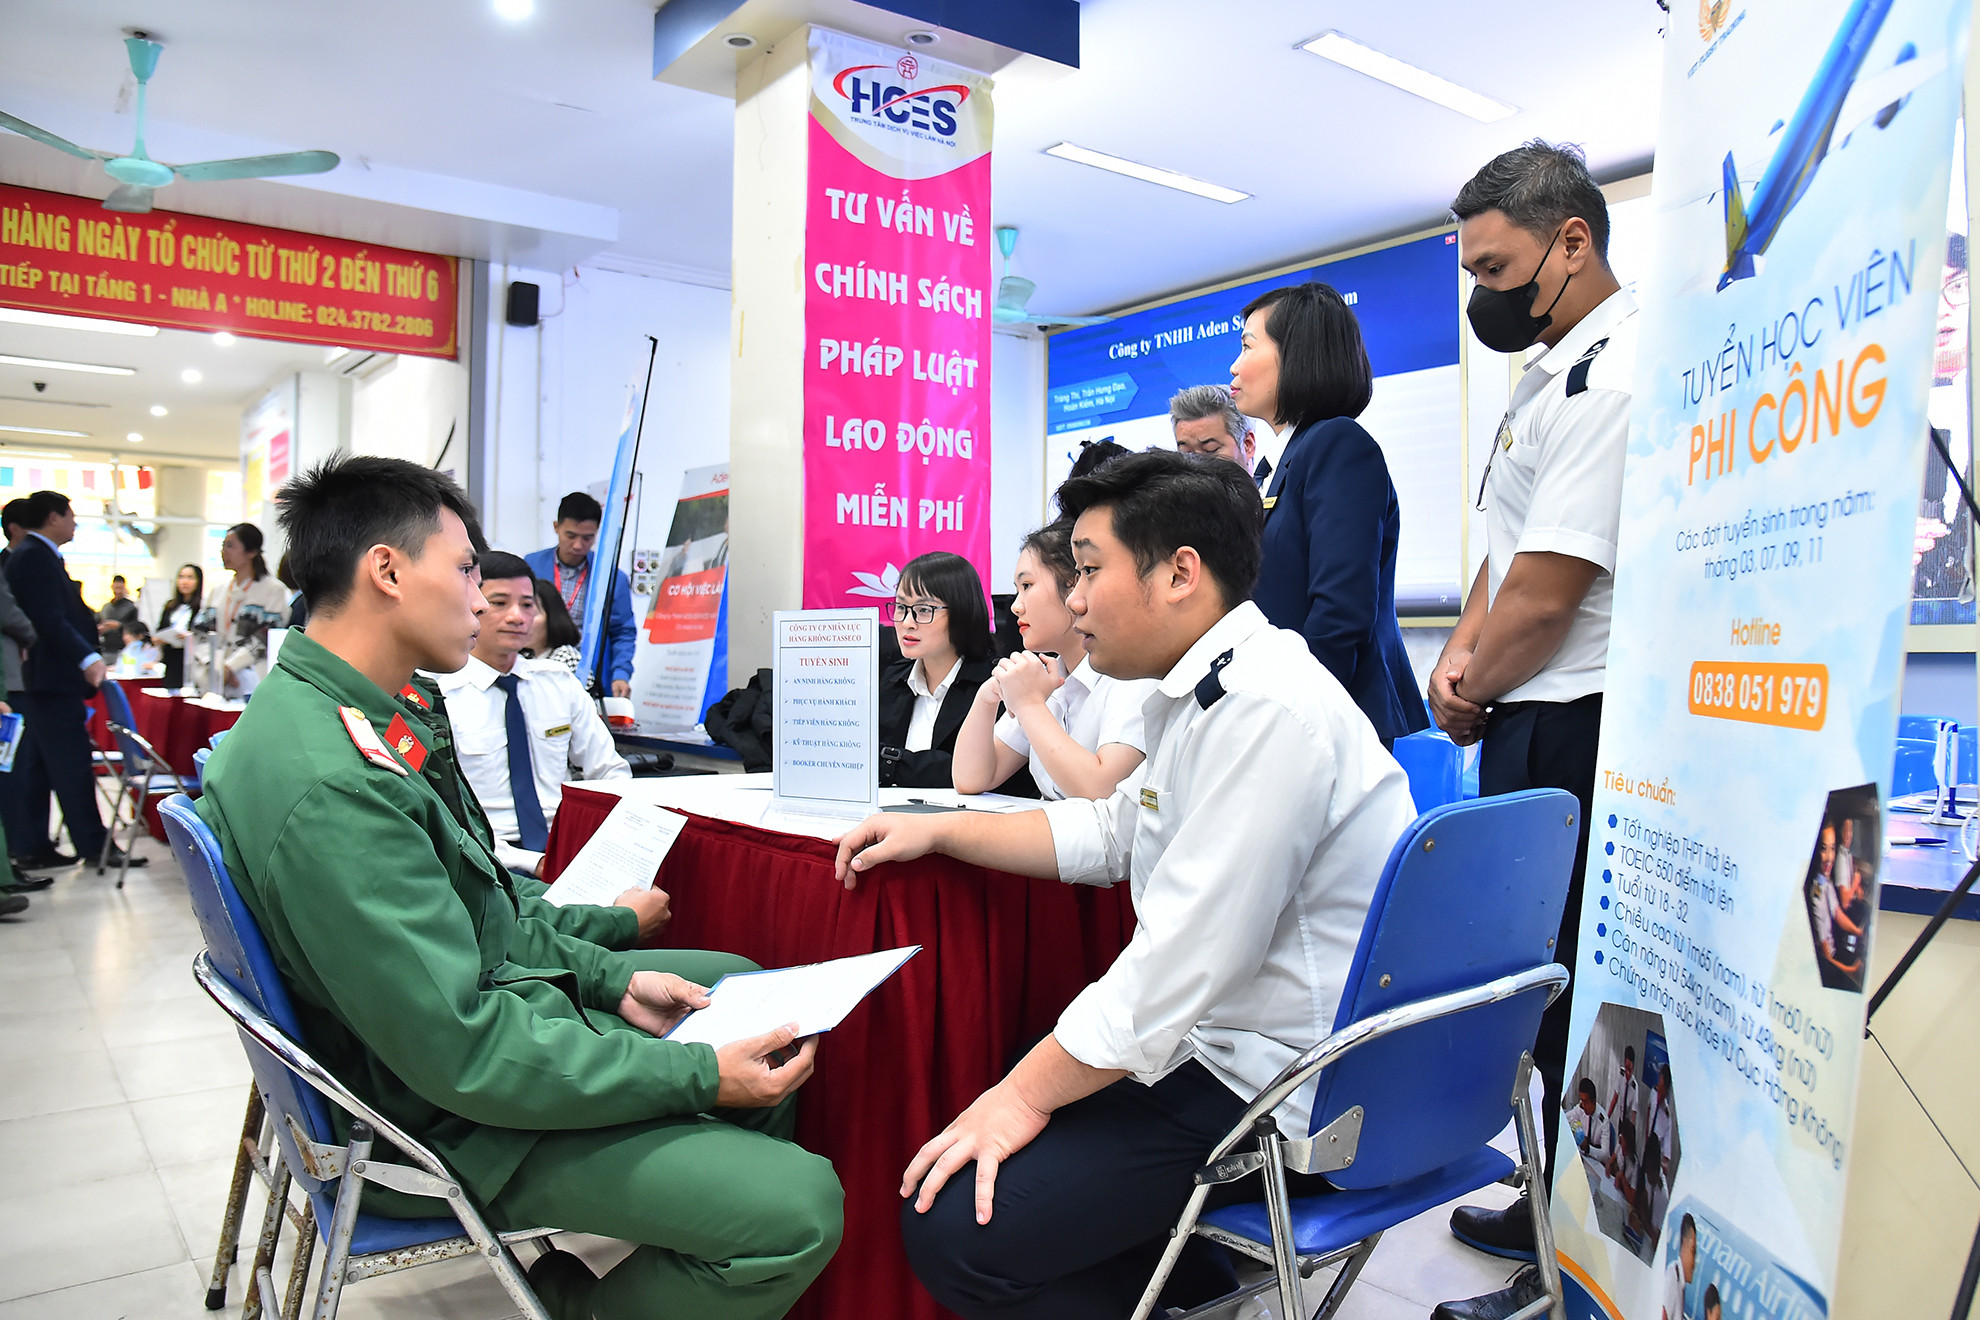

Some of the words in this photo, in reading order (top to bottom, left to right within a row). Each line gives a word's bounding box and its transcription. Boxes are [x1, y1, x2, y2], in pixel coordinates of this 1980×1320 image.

[850, 116, 872, 126] TRUNG
[852, 77, 957, 136] HCES
[825, 187, 868, 224] TƯ
[876, 189, 934, 237] VẤN
[943, 204, 975, 247] VỀ
[2, 202, 71, 253] HÀNG
[77, 216, 142, 262] NGÀY
[147, 218, 177, 267] TỔ
[181, 232, 241, 276] CHỨC
[246, 238, 275, 280] TỪ
[278, 245, 320, 286] THỨ
[322, 255, 335, 288] 2
[340, 249, 380, 294] ĐẾN
[385, 260, 424, 300] THỨ
[427, 269, 439, 302] 6
[0, 260, 42, 289] TIẾP
[48, 270, 80, 298] TẠI
[85, 270, 136, 302] TẦNG
[142, 283, 151, 304] 1
[172, 286, 211, 312] NHÀ
[214, 292, 228, 313] A
[246, 296, 313, 324] HOLINE:
[815, 261, 908, 306] CHÍNH
[917, 276, 982, 320] SÁCH
[1108, 342, 1138, 360] Công
[1140, 339, 1152, 356] ty
[1154, 326, 1194, 349] TNHH
[1196, 320, 1229, 340] Aden
[1682, 322, 1754, 410] TUYỂN
[1760, 297, 1824, 371] HỌC
[1834, 238, 1916, 330] VIÊN
[820, 338, 904, 378] PHÁP
[913, 350, 978, 396] LUẬT
[826, 415, 886, 452] LAO
[896, 418, 973, 465] ĐỘNG
[1688, 408, 1736, 486] PHI
[1748, 343, 1888, 464] CÔNG
[836, 482, 908, 528] MIỄN
[918, 495, 964, 534] PHÍ
[1676, 530, 1700, 552] Các
[1702, 522, 1721, 550] đợt
[1724, 508, 1758, 546] tuyển
[1760, 507, 1786, 534] sinh
[1790, 504, 1829, 529] trong
[1832, 490, 1876, 519] năm:
[1704, 555, 1737, 581] tháng
[1740, 550, 1759, 574] 03,
[1760, 545, 1780, 571] 07,
[1782, 540, 1803, 568] 09,
[1808, 536, 1823, 564] 11
[789, 624, 808, 632] CÔNG
[809, 624, 817, 632] TY
[818, 624, 826, 632] CP
[828, 622, 846, 631] NHÂN
[847, 624, 861, 632] LỰC
[789, 634, 807, 642] HÀNG
[808, 634, 832, 642] KHÔNG
[832, 634, 862, 642] TASSECO
[1730, 617, 1782, 646] Hotline
[828, 658, 848, 666] SINH
[793, 698, 808, 706] PHỤC
[818, 698, 834, 706] HÀNH
[835, 698, 856, 706] KHÁCH
[1694, 672, 1735, 708] 0838
[1738, 674, 1774, 712] 051
[1779, 676, 1822, 718] 979
[802, 739, 821, 748] THUẬT
[822, 739, 838, 748] HÀNG
[840, 740, 861, 748] KHÔNG
[806, 718, 820, 726] VIÊN
[838, 719, 860, 727] KHÔNG
[816, 760, 840, 768] CHUYÊN
[841, 762, 864, 770] NGHIỆP
[1604, 770, 1634, 794] Tiêu
[1638, 777, 1676, 806] chuẩn:
[1623, 817, 1642, 840] Tốt
[1644, 828, 1680, 858] nghiệp
[1682, 836, 1704, 864] THPT
[1704, 847, 1719, 872] trở
[1720, 854, 1738, 882] lên
[1618, 872, 1642, 900] Tuổi
[1644, 883, 1656, 905] từ
[1660, 890, 1670, 912] 18
[1676, 899, 1689, 924] 32
[1620, 844, 1654, 874] TOEIC
[1656, 858, 1674, 882] 550
[1701, 880, 1716, 904] trở
[1716, 886, 1734, 916] lên
[1614, 902, 1650, 932] Chiều
[1652, 922, 1672, 945] cao
[1674, 930, 1686, 953] từ
[1687, 937, 1712, 972] 1m65
[1752, 980, 1766, 1008] từ
[1768, 990, 1804, 1035] 1m60
[1804, 1017, 1834, 1062] (nữ)
[1612, 929, 1638, 958] Cân
[1640, 946, 1667, 979] nặng
[1669, 959, 1680, 982] từ
[1680, 967, 1703, 1006] 54kg
[1740, 1011, 1754, 1040] từ
[1756, 1026, 1786, 1071] 48kg
[1788, 1048, 1818, 1093] (nữ)
[1608, 957, 1648, 998] Chứng
[1650, 982, 1674, 1013] nhận
[1676, 1002, 1694, 1028] sức
[1695, 1011, 1720, 1050] khỏe
[1721, 1034, 1734, 1062] từ
[1736, 1047, 1761, 1086] Cục
[1763, 1068, 1799, 1125] Hàng
[1801, 1100, 1844, 1171] Không
